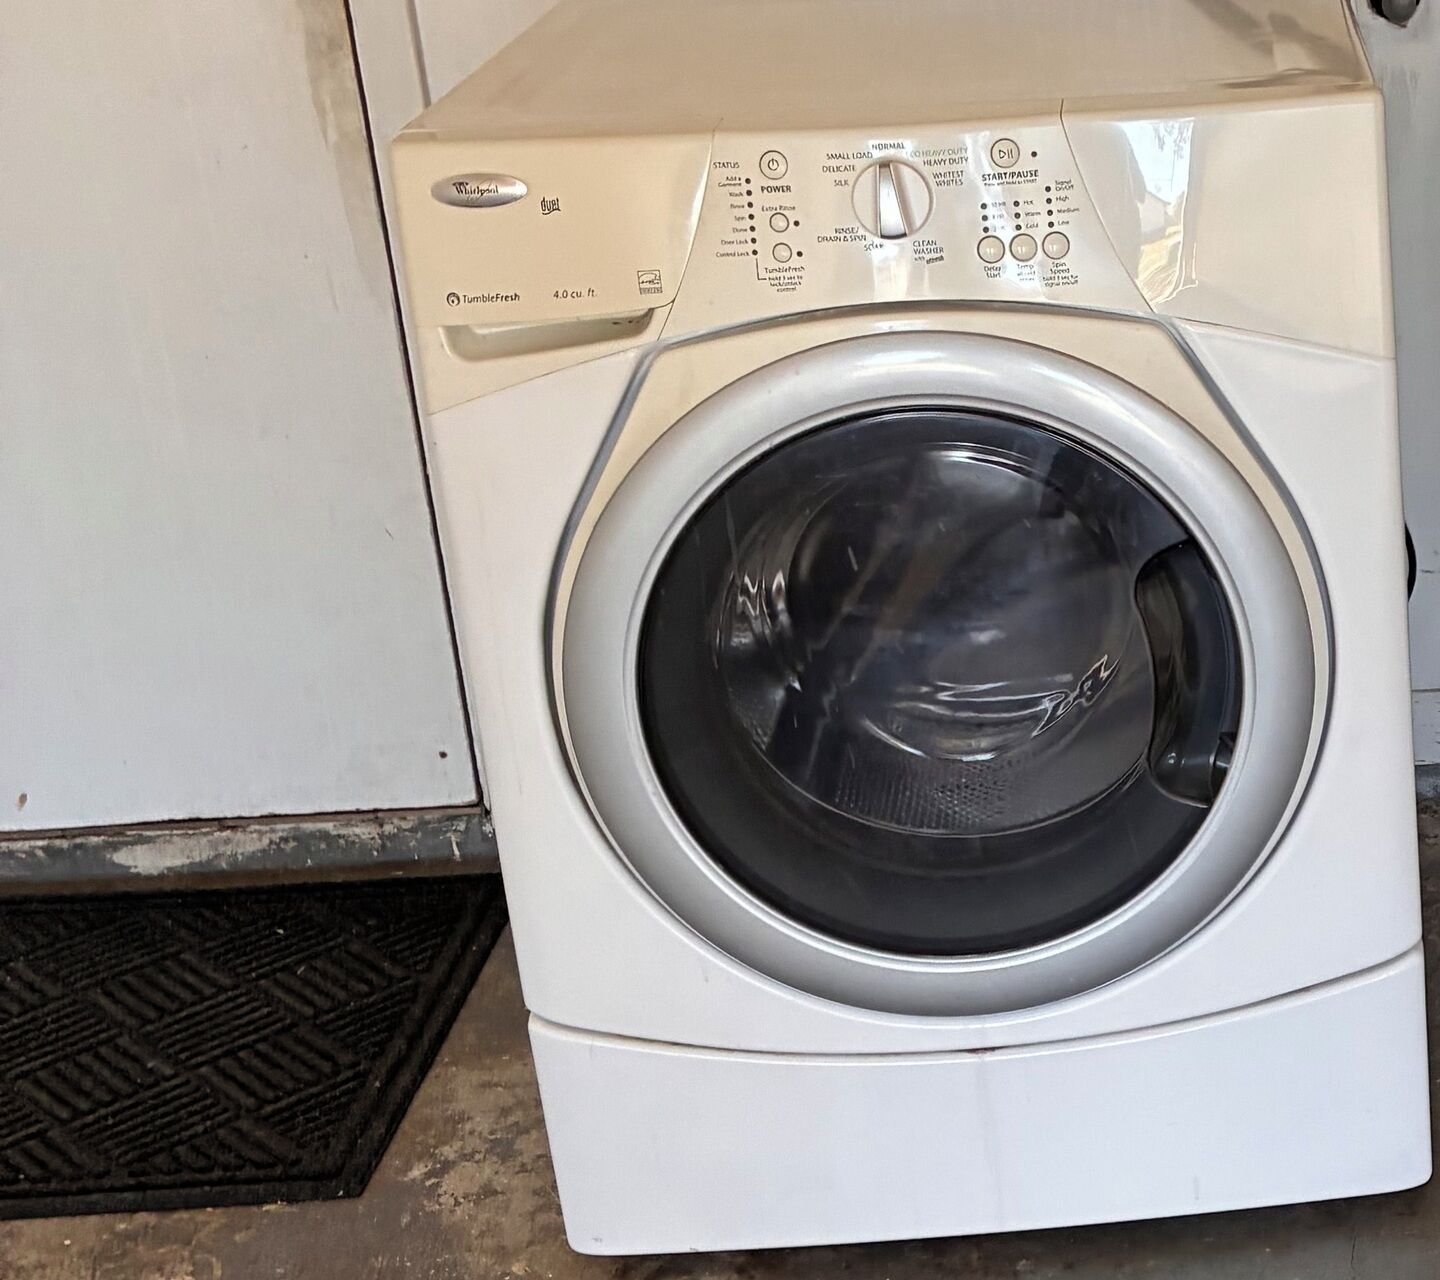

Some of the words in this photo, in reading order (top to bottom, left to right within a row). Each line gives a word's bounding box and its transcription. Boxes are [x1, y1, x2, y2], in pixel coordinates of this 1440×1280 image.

[872, 142, 905, 150] NORMAL
[826, 152, 851, 160] SMALL
[713, 161, 740, 169] STATUS
[923, 158, 947, 166] HEAVY
[948, 157, 968, 165] DUTY
[822, 165, 855, 173] DELICATE
[932, 171, 964, 180] WHITEST
[982, 170, 1039, 181] START/PAUSE
[834, 179, 849, 187] SILK
[935, 179, 963, 187] WHITES
[453, 180, 499, 196] Whirlpool
[760, 185, 792, 193] POWER
[541, 197, 561, 215] duet
[834, 227, 859, 235] RINSE/
[817, 235, 841, 243] DRAIN
[913, 247, 944, 255] WASHER
[765, 266, 805, 274] TumbleFresh
[462, 292, 520, 303] TumbleFresh
[553, 289, 568, 299] 4.0
[570, 290, 584, 299] cu.
[587, 288, 598, 297] ft.
